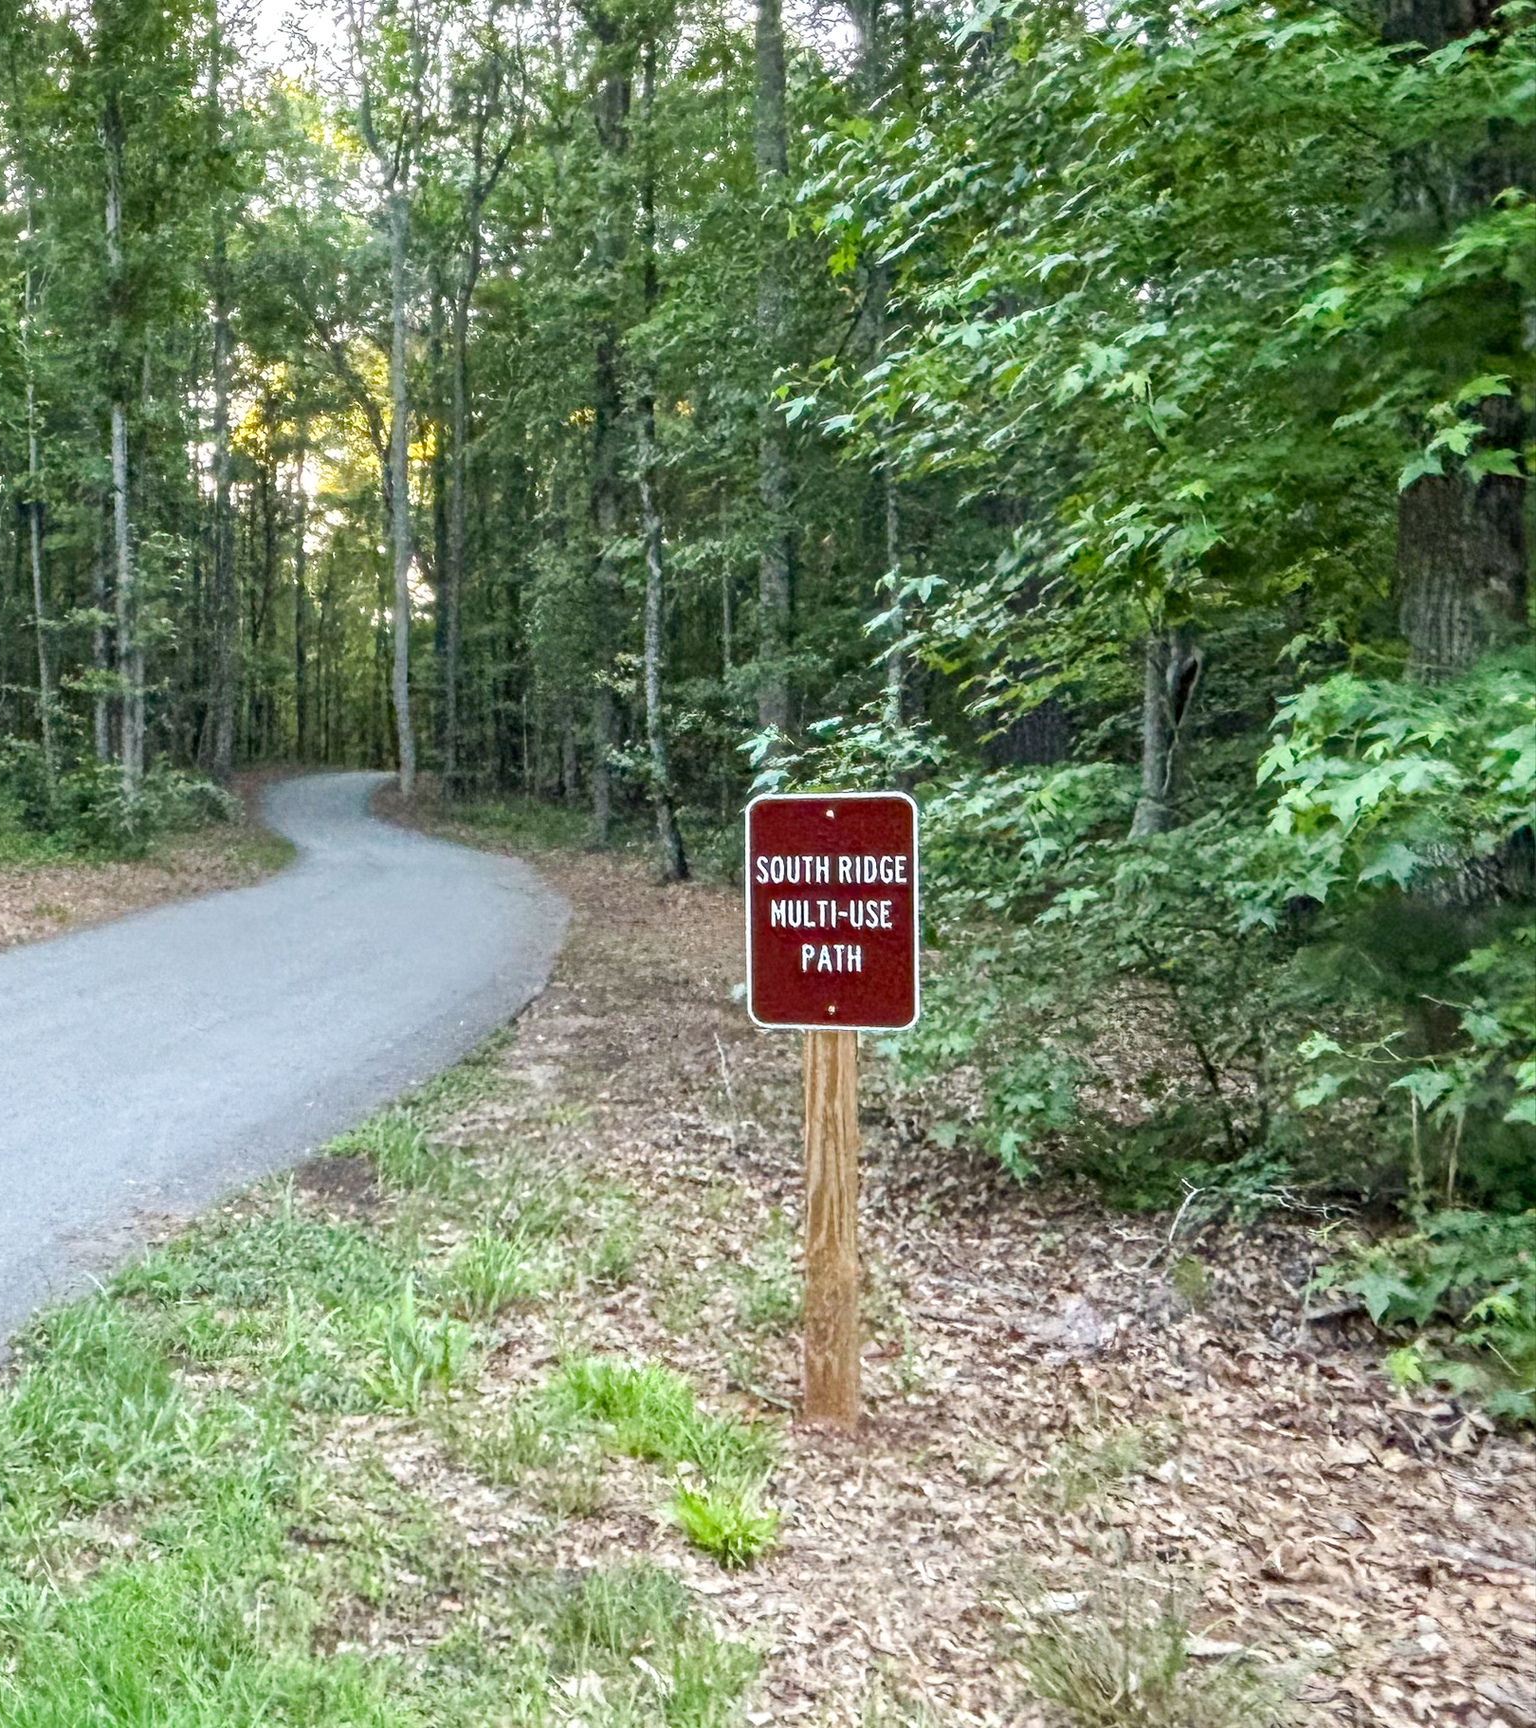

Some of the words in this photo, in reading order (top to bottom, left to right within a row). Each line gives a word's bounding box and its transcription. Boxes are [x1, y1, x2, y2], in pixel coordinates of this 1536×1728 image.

[755, 855, 830, 885] SOUTH
[838, 855, 908, 884] RIDGE
[770, 899, 893, 930] MULTI-USE
[801, 943, 862, 973] PATH
